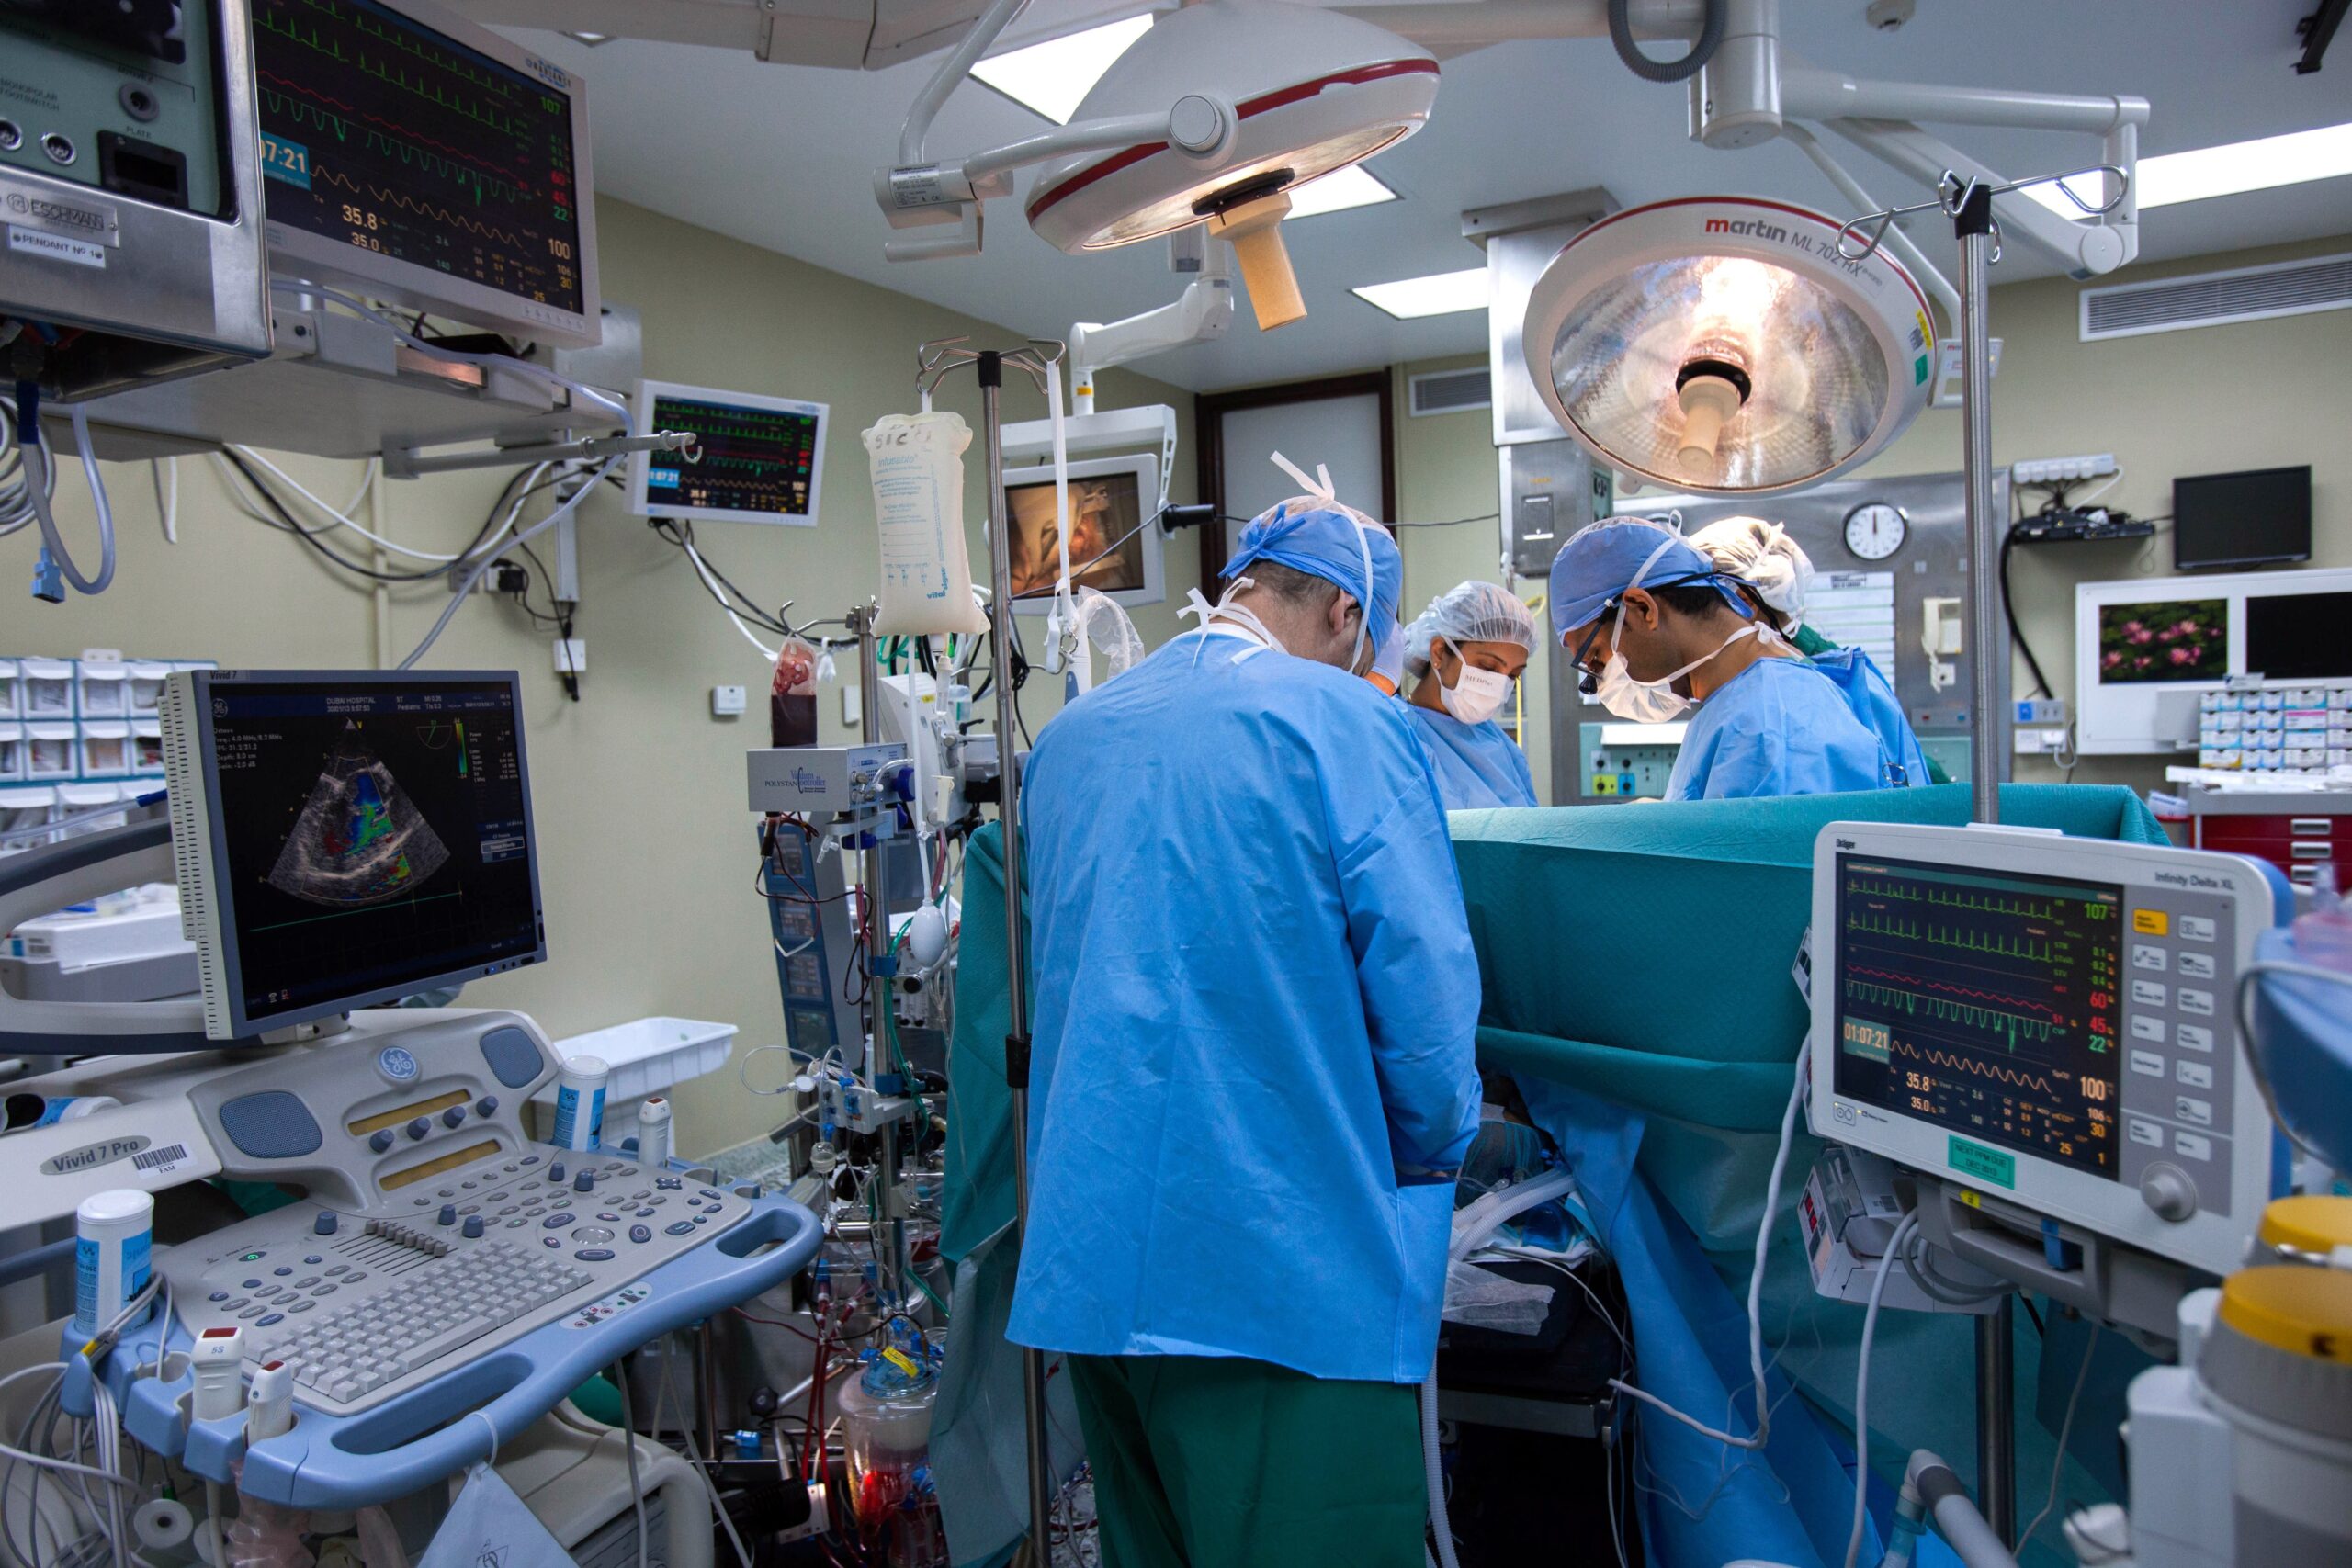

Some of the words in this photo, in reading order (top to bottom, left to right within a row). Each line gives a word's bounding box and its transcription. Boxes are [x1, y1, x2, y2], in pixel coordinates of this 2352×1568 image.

[539, 96, 561, 116] 107
[126, 125, 152, 139] PLATE
[31, 198, 104, 231] ESCHMANN
[342, 204, 379, 231] 35.8
[552, 205, 570, 223] 22
[22, 234, 69, 253] PENDANT
[351, 232, 380, 253] 35.0
[1705, 218, 1787, 243] martin
[1790, 231, 1812, 253] ML
[548, 237, 571, 261] 100
[559, 276, 573, 290] 30
[533, 289, 546, 303] 25
[926, 589, 947, 600] vital
[209, 670, 229, 681] Vivid
[346, 696, 376, 705] HOSPITAL
[1836, 838, 1856, 851] Dräger
[2154, 871, 2188, 886] Infinity
[2189, 874, 2218, 888] Delta
[2221, 878, 2234, 890] XL
[2084, 903, 2109, 920] 107
[2088, 991, 2108, 1010] 60
[2088, 1015, 2107, 1034] 45
[1844, 1022, 1889, 1051] 01:07:21
[2087, 1036, 2106, 1054] 22
[1905, 1071, 1930, 1092] 35.8
[2080, 1076, 2107, 1101] 100
[1910, 1096, 1930, 1112] 35.0
[2086, 1107, 2106, 1122] 106
[2089, 1122, 2107, 1139] 30
[52, 1149, 96, 1172] Vivid
[97, 1145, 107, 1160] 7
[111, 1140, 140, 1156] Pro
[1954, 1143, 1973, 1156] NEXT
[1990, 1155, 2007, 1168] DUE
[2058, 1141, 2074, 1156] 25
[1965, 1157, 1981, 1170] DEC
[2098, 1151, 2106, 1165] 1
[158, 1164, 176, 1175] FAM
[210, 1345, 225, 1355] 5S
